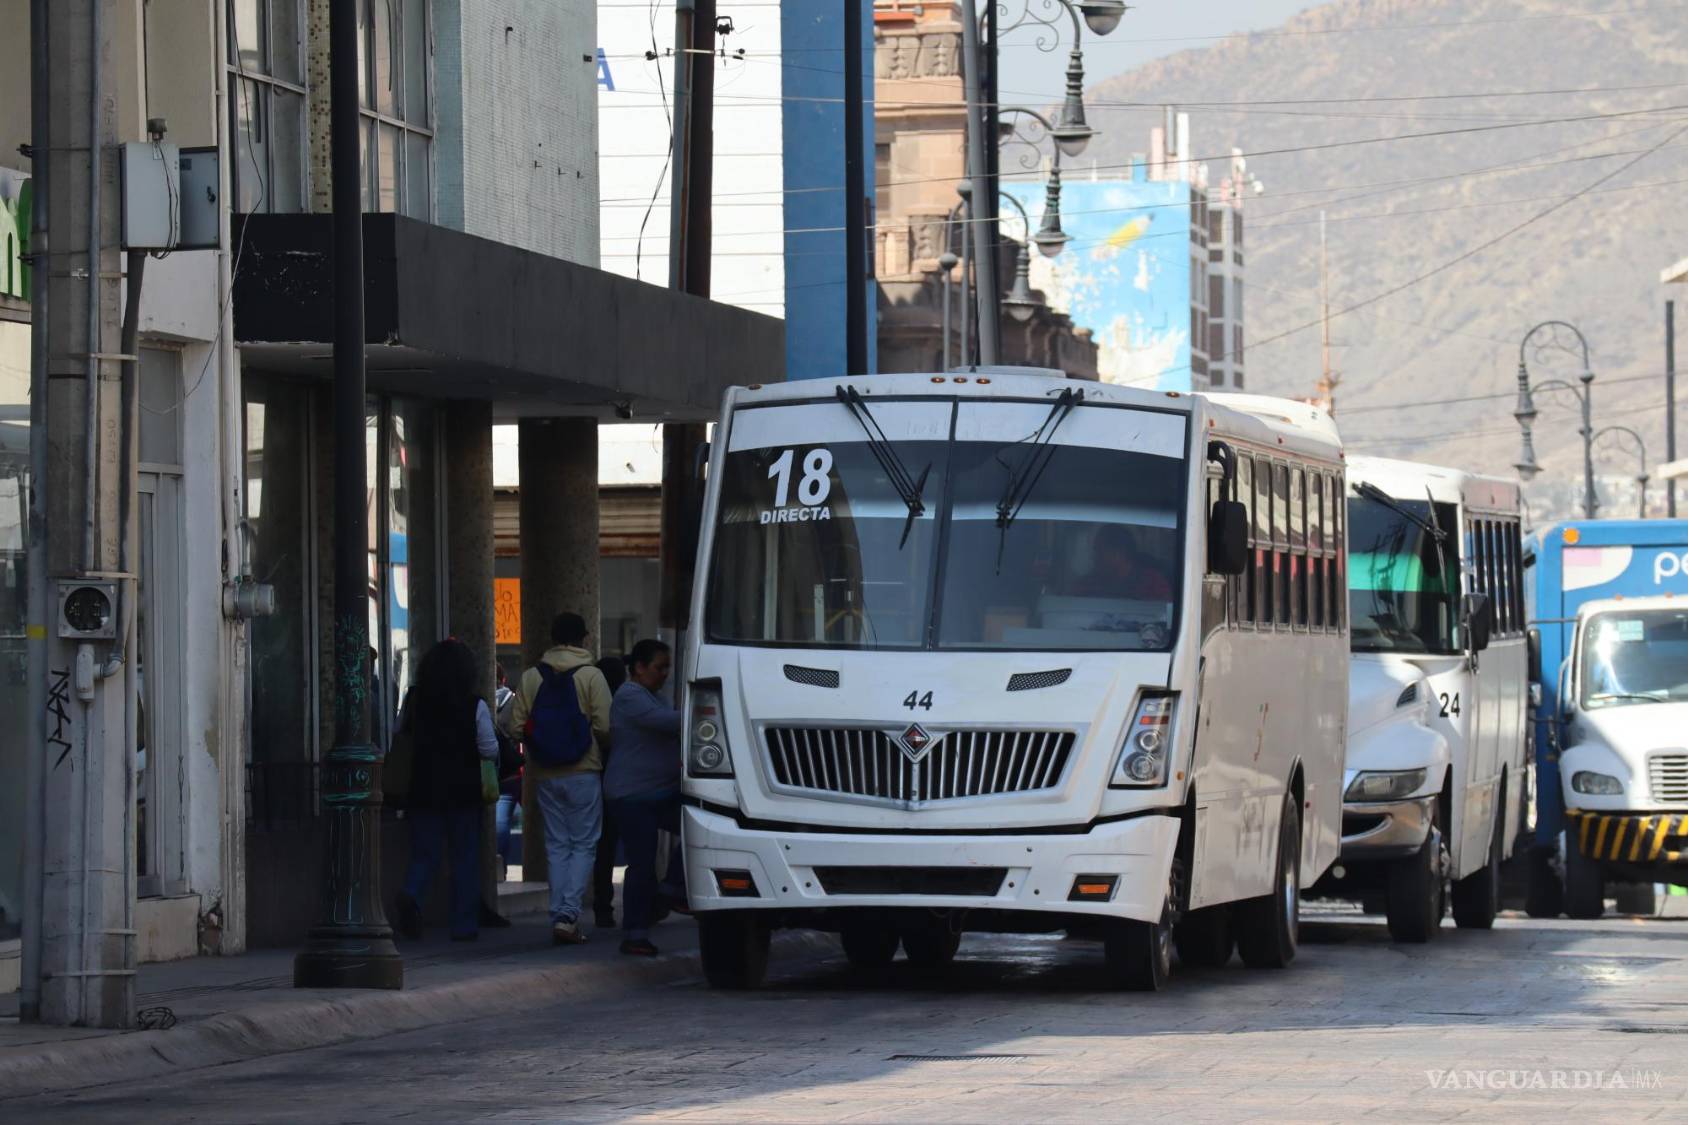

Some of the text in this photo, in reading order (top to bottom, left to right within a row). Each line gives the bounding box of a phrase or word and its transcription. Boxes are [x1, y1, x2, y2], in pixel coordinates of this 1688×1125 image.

[767, 448, 833, 507] 18
[760, 507, 831, 524] DIRECTA
[903, 690, 933, 711] 44
[1439, 692, 1460, 718] 24
